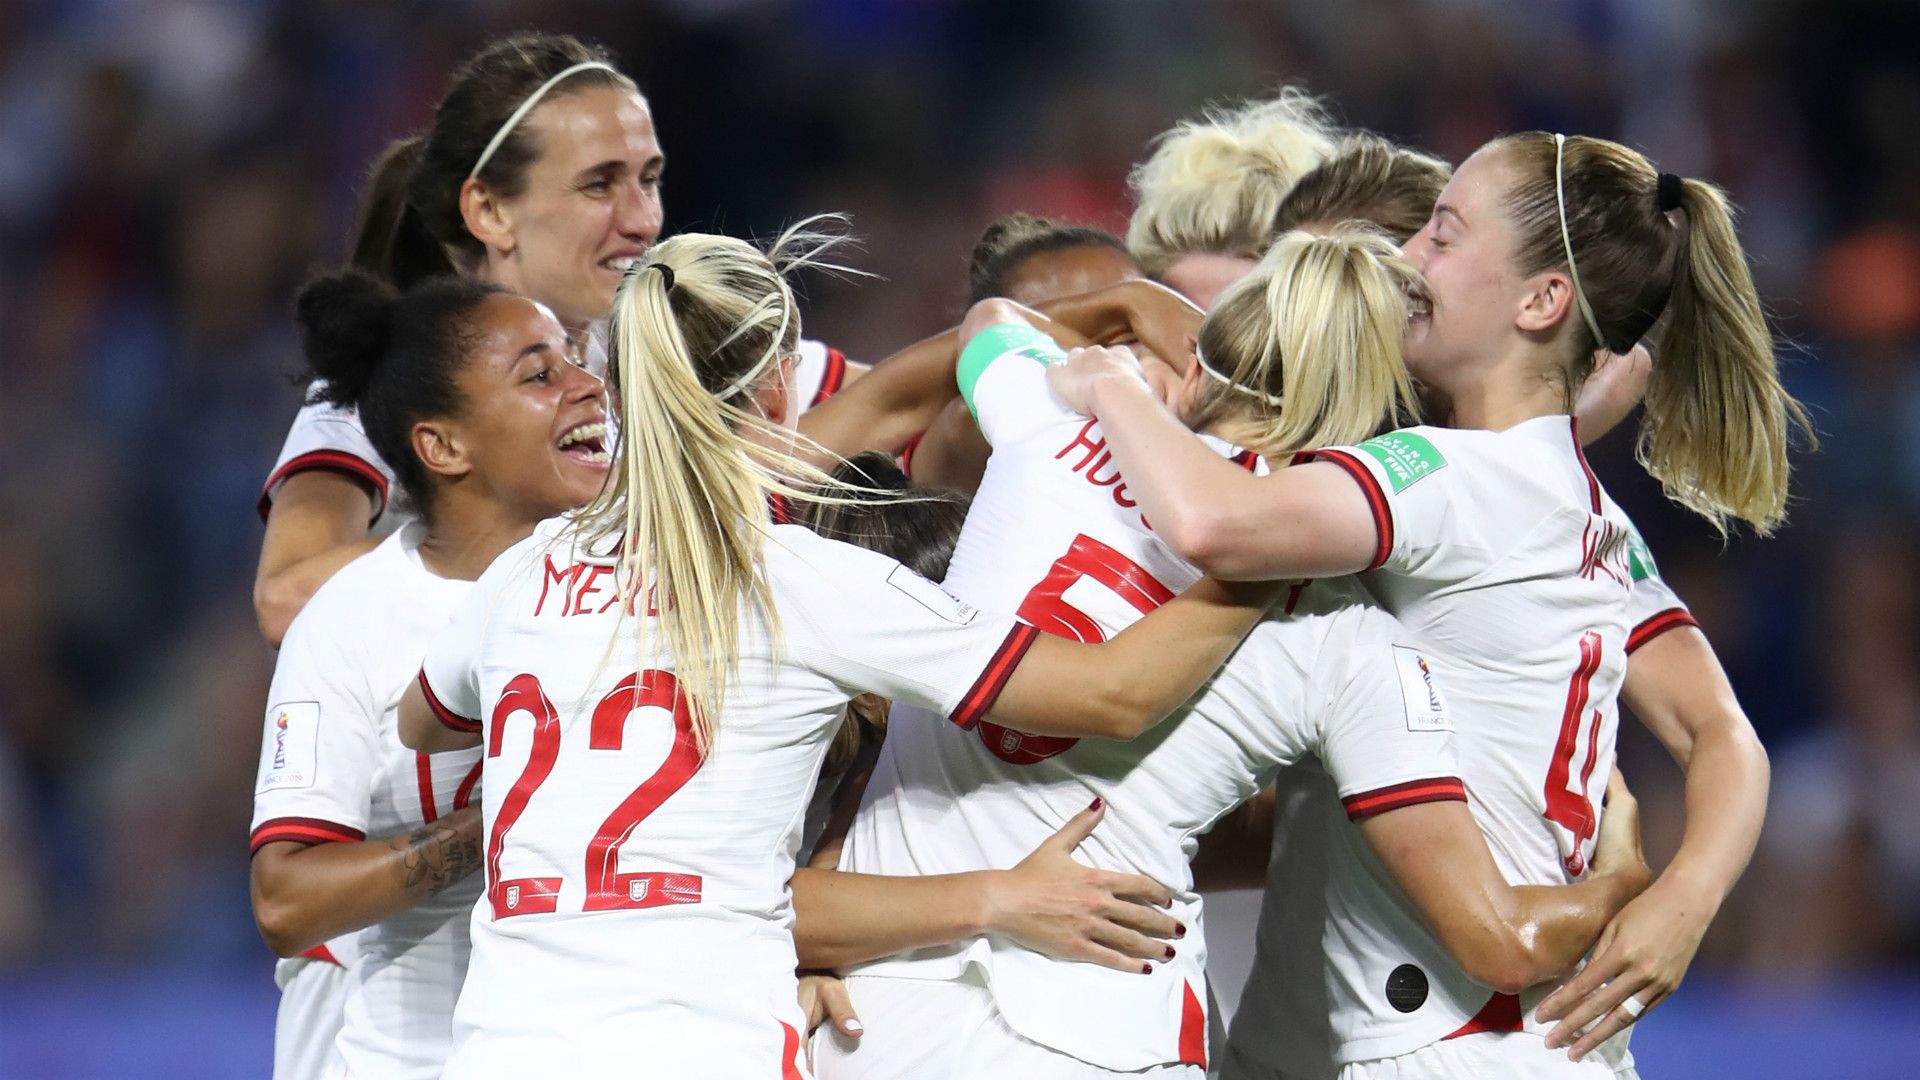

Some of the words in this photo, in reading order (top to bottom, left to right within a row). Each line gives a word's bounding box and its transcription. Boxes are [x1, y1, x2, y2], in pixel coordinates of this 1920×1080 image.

[1383, 456, 1411, 482] FIFA
[977, 533, 1176, 766] 5
[1543, 631, 1603, 877] 4
[487, 669, 711, 922] 22
